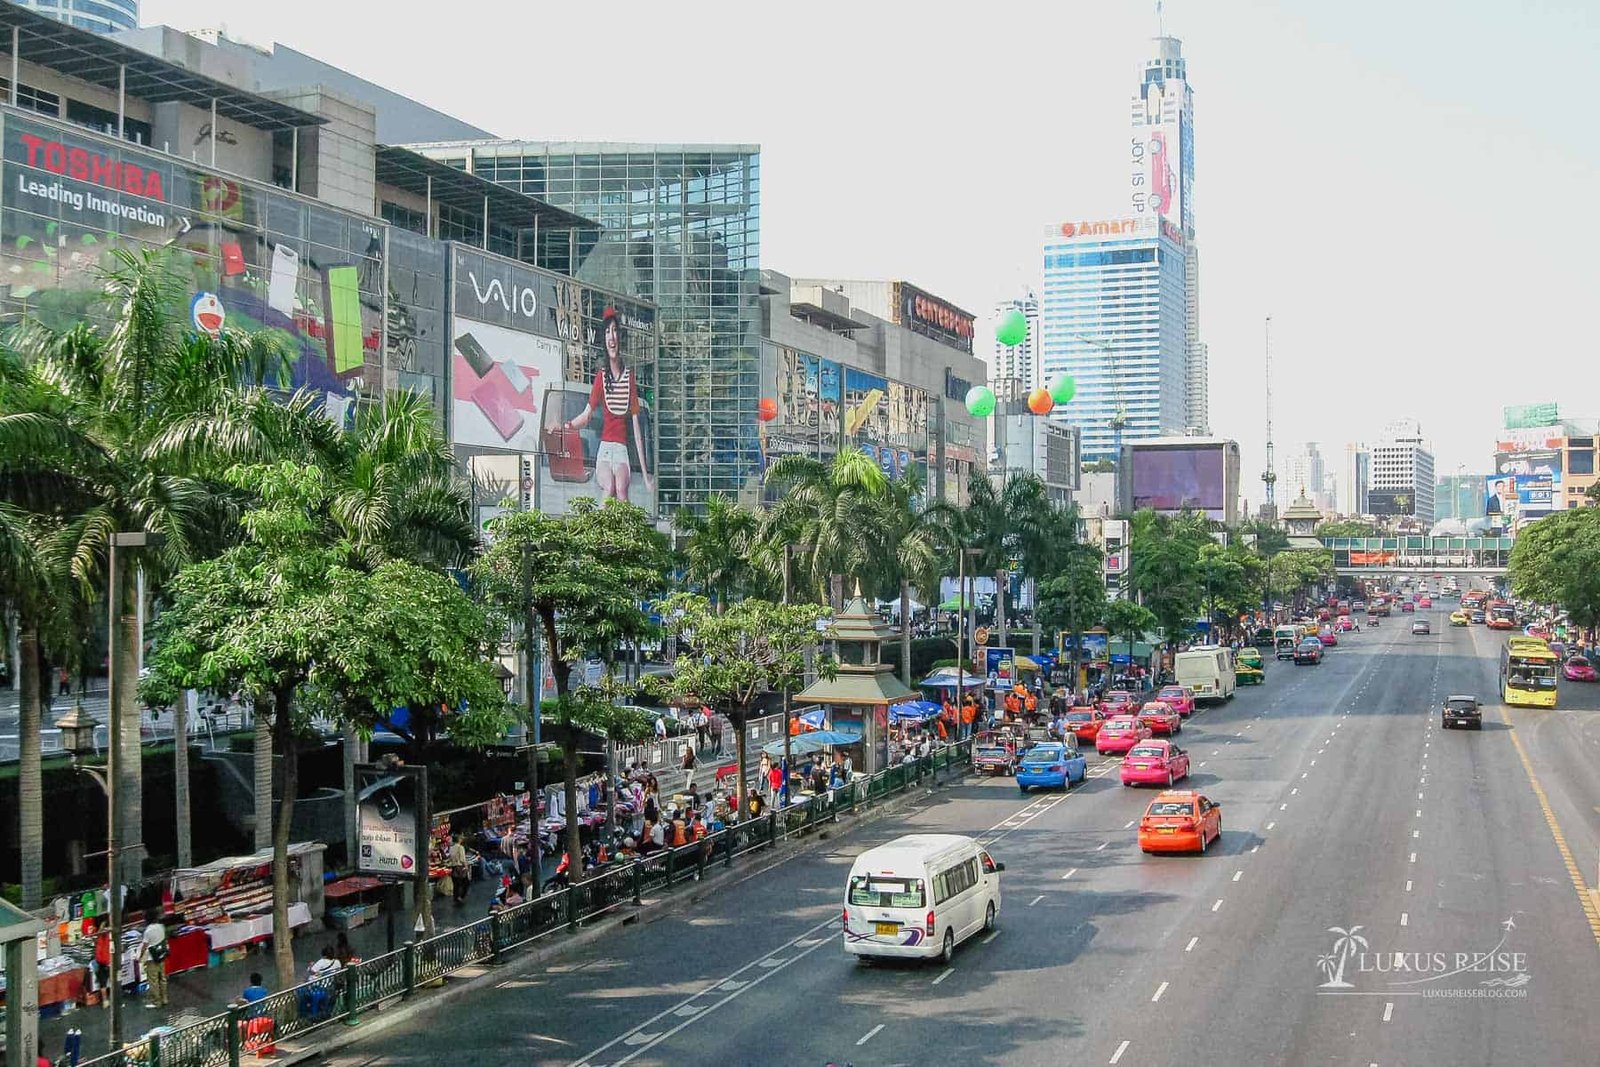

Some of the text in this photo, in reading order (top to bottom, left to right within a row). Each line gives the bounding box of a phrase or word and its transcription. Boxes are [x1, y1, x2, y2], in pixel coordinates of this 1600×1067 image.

[21, 133, 166, 203] TOSHIBA
[1131, 137, 1145, 213] JOY IS UP
[19, 174, 165, 227] Leading Innovation
[468, 271, 537, 317] VAIO
[556, 319, 597, 344] VAIO W
